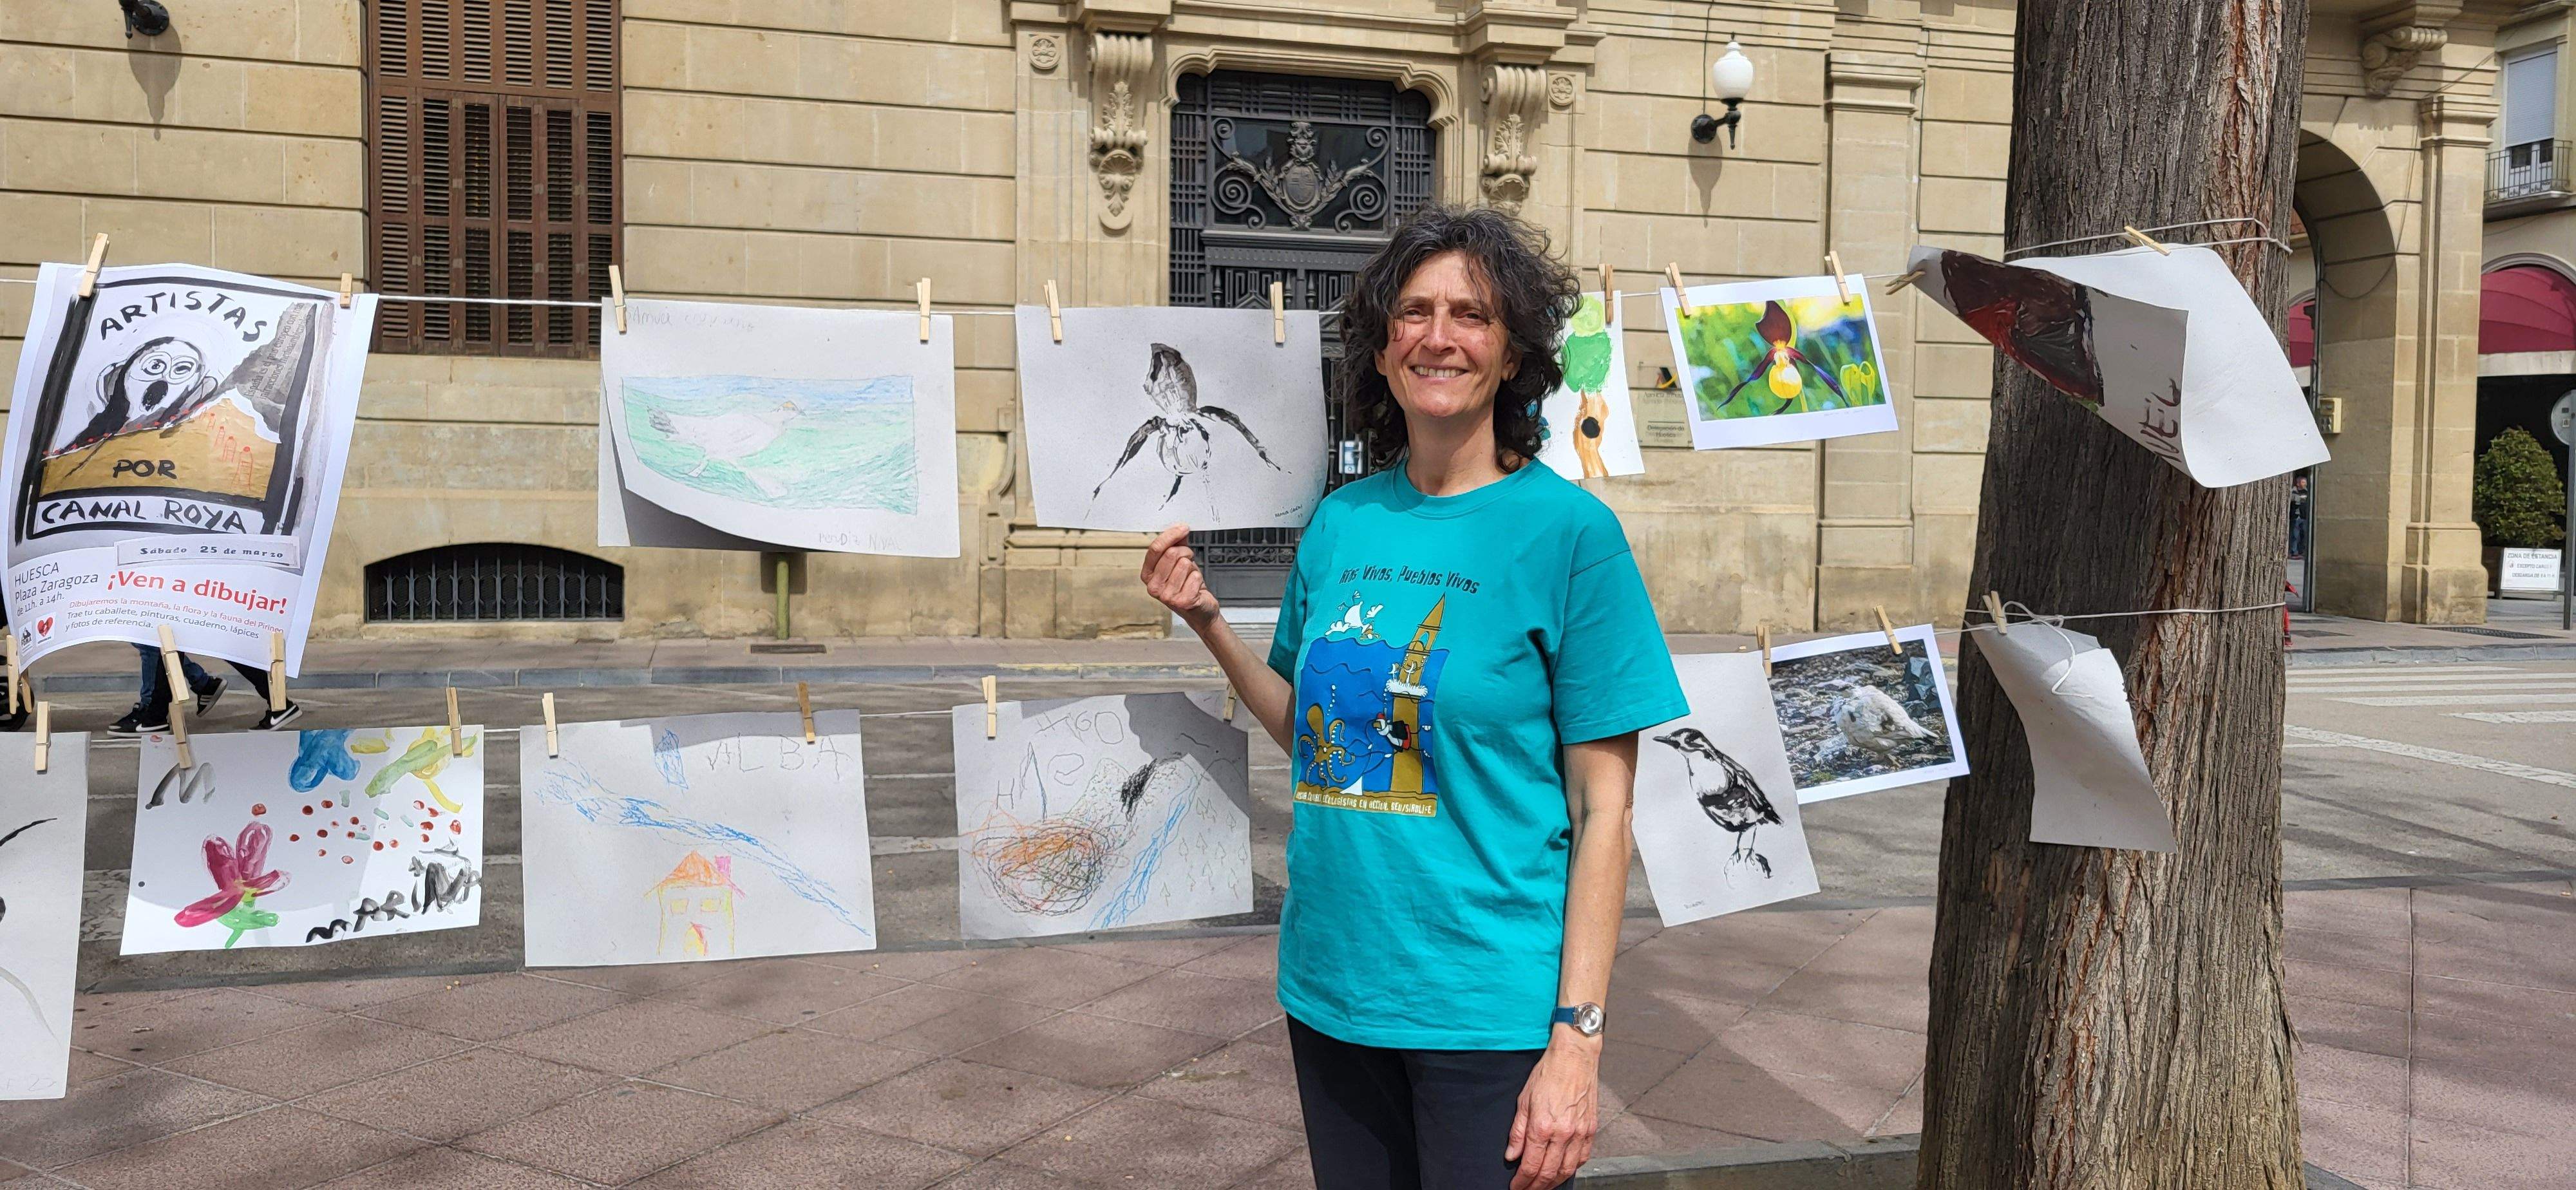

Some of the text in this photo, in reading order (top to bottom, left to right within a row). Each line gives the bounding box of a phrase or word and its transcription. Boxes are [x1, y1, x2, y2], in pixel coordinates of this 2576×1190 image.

[100, 290, 267, 342] ARTISTAS
[113, 459, 178, 480] POR
[41, 499, 247, 534] CANAL ROYA
[139, 547, 187, 555] Sábado
[242, 549, 283, 558] marzo
[15, 562, 59, 587] HUESCA
[15, 574, 99, 604] Plaza Zaragoza
[1396, 565, 1443, 586] Pueblos
[1444, 571, 1481, 594] Vivos
[107, 571, 287, 614] ¡Ven a dibujar!
[69, 598, 118, 609] Dibujaremos
[129, 599, 171, 610] montaña,
[182, 605, 202, 616] flora
[210, 609, 218, 618] la
[219, 612, 243, 623] fauna
[243, 618, 257, 627] del
[70, 621, 90, 629] fotos
[104, 617, 154, 628] referencia.
[95, 607, 138, 616] caballete,
[140, 610, 181, 623] pinturas,
[183, 616, 229, 632] cuaderno,
[230, 625, 260, 639] lápices
